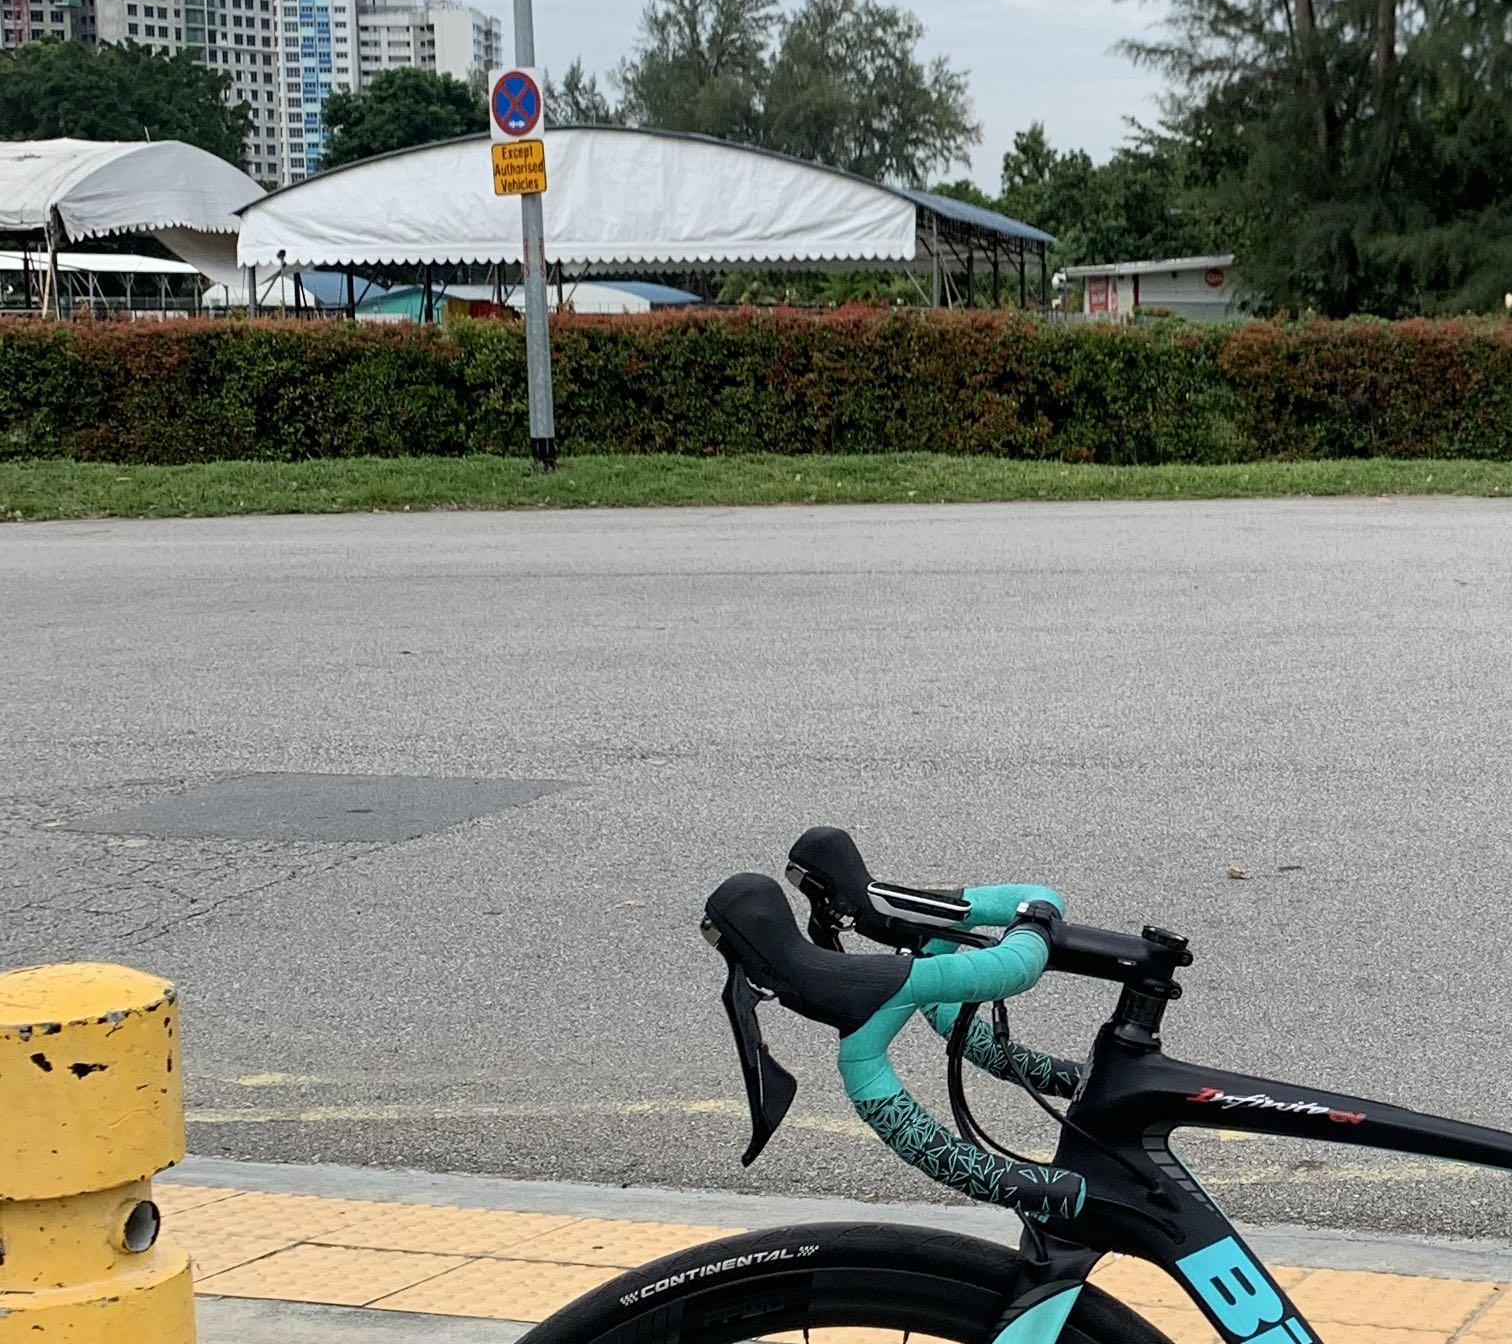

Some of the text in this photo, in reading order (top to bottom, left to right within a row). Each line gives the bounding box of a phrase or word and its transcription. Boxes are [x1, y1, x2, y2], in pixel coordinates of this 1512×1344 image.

[502, 145, 533, 162] Except
[495, 162, 544, 176] Authorised
[501, 177, 539, 192] Vehicles
[640, 1248, 794, 1299] CONTINENTAL
